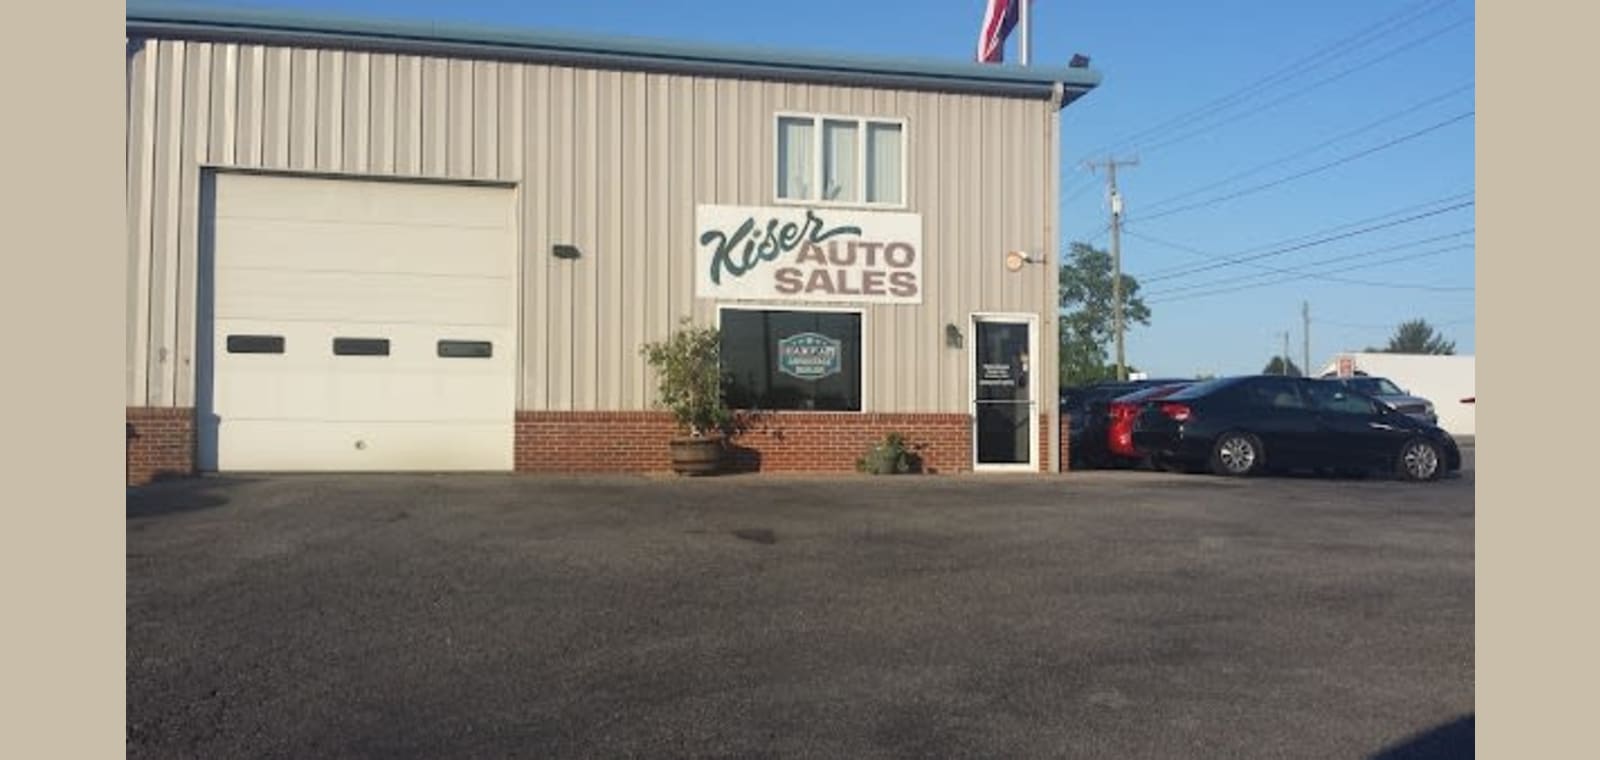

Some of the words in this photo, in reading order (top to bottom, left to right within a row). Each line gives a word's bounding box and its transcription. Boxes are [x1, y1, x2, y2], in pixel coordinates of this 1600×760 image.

[700, 209, 862, 285] Kiser
[795, 240, 916, 268] AUTO
[774, 267, 918, 297] SALES
